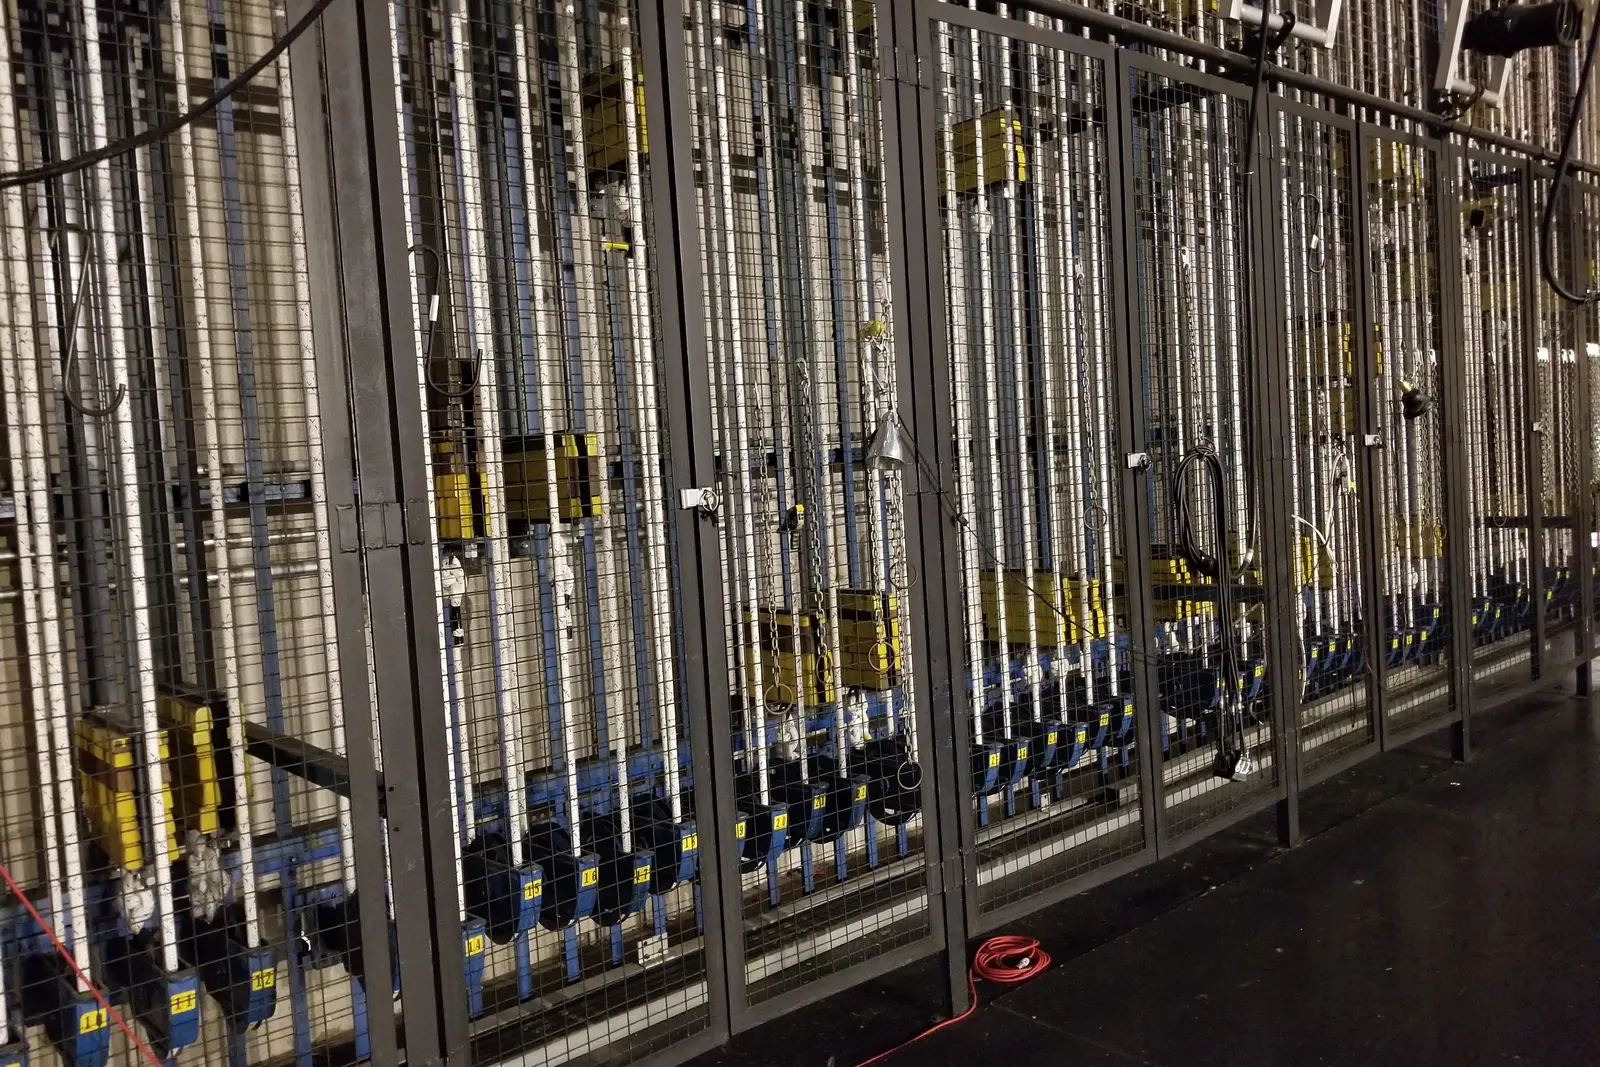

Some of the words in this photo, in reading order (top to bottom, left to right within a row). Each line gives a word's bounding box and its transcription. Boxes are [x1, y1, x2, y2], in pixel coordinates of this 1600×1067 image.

[775, 816, 786, 828] 20
[584, 870, 598, 884] 16
[527, 883, 540, 897] 15
[468, 938, 481, 953] 14
[256, 970, 272, 988] 12
[174, 994, 193, 1011] 11
[84, 1012, 103, 1030] 10
